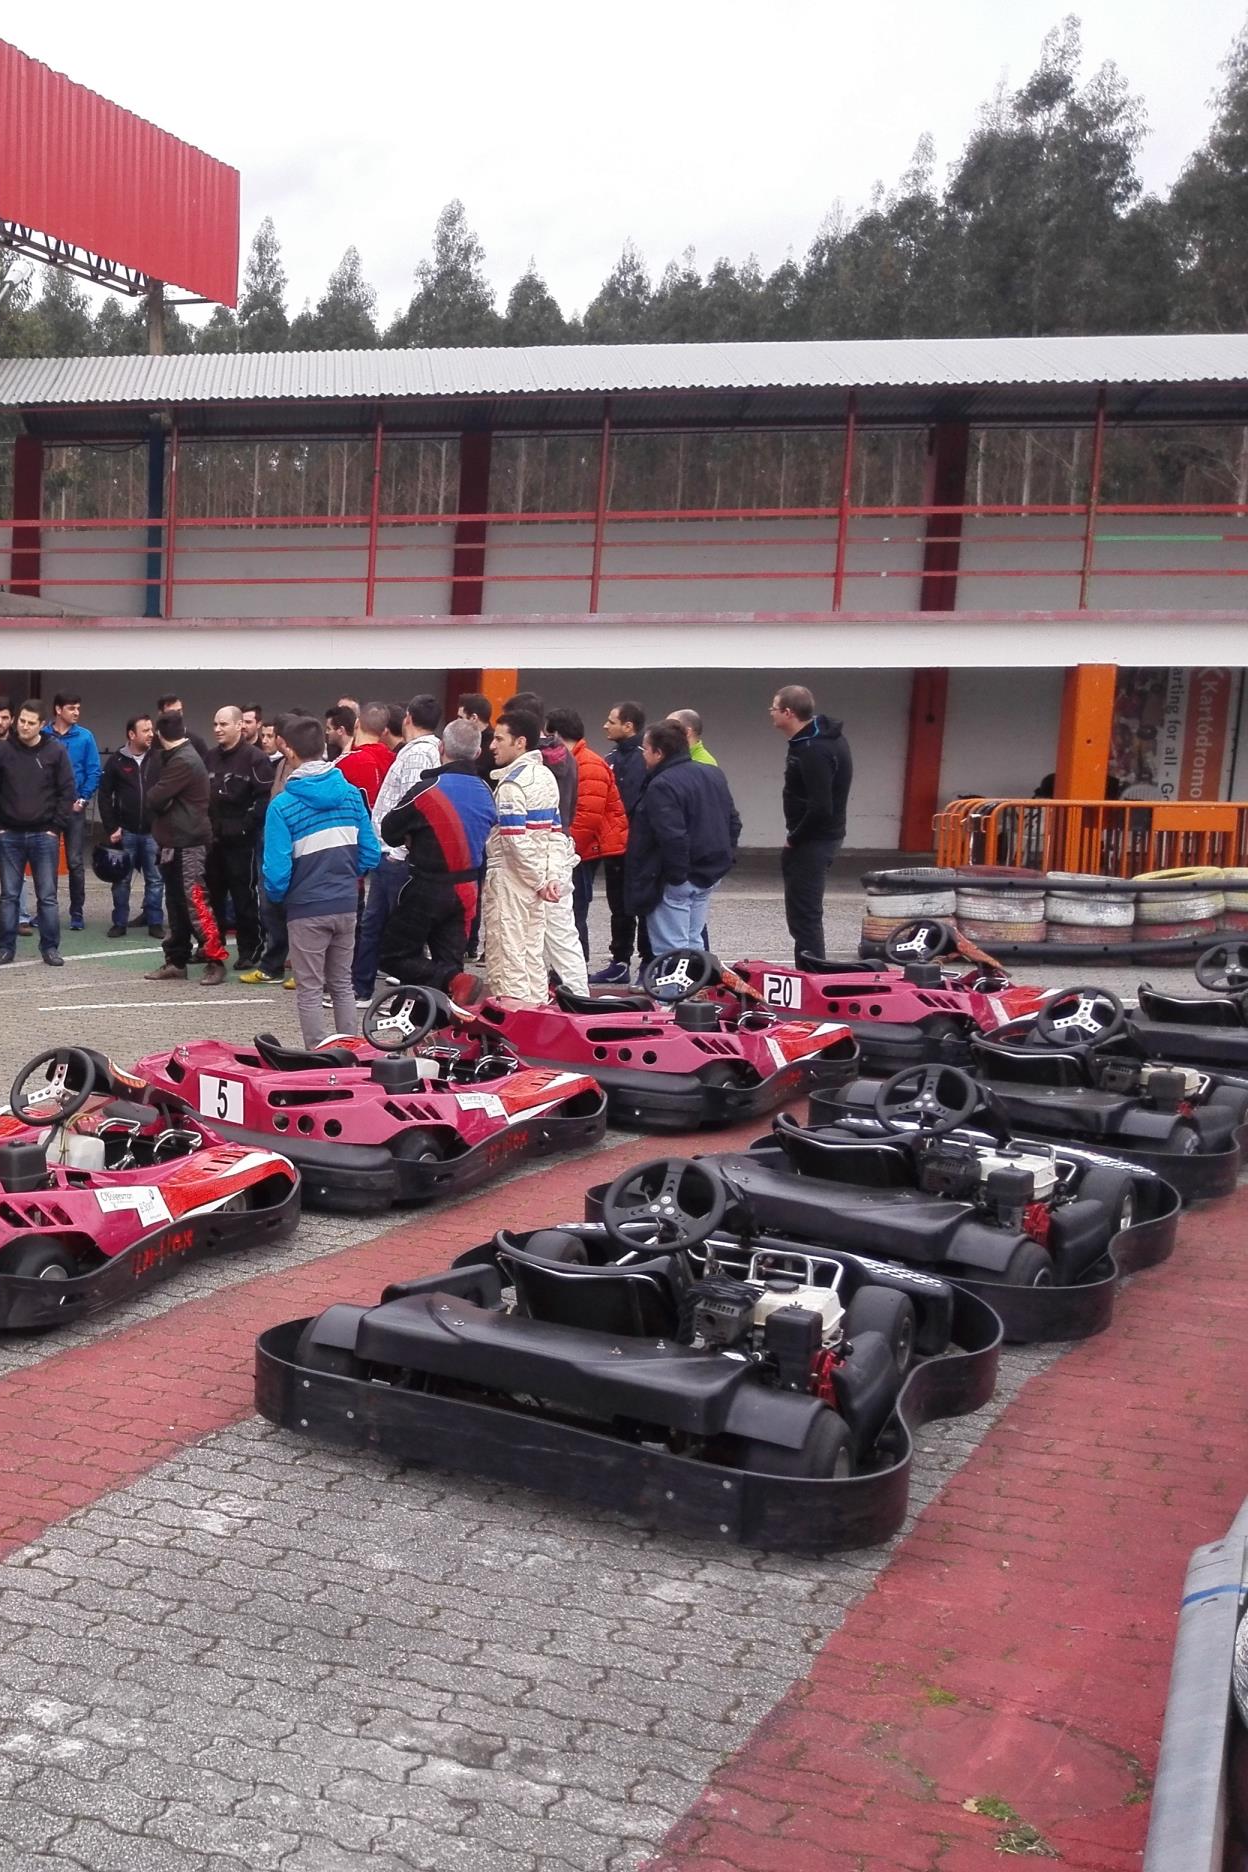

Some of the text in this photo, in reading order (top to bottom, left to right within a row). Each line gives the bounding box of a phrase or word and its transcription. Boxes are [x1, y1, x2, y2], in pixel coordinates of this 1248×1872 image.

[1166, 667, 1184, 714] arting
[1166, 720, 1181, 741] for
[1189, 681, 1219, 798] Kartódromo
[1164, 744, 1178, 766] all
[768, 976, 792, 1007] 20
[217, 1079, 228, 1119] 5
